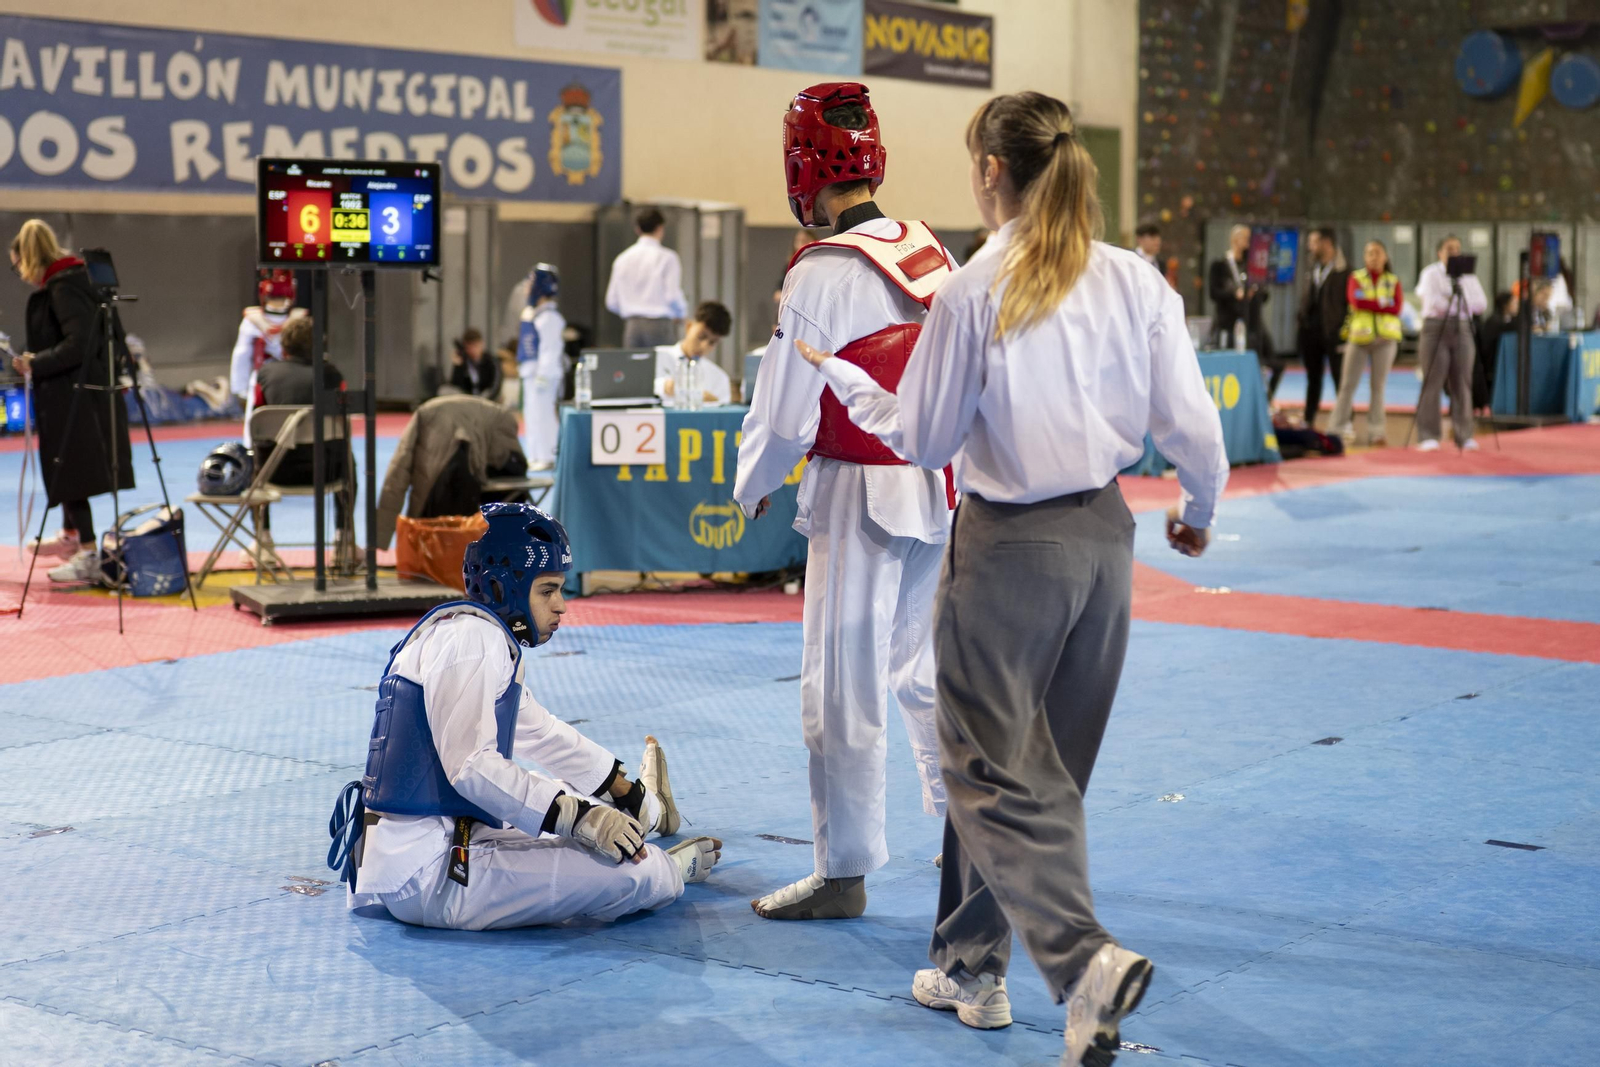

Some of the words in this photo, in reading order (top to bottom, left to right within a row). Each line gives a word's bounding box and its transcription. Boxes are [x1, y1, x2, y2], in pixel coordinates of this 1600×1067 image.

[264, 59, 535, 123] MUNICIPAL
[306, 179, 332, 189] Ricardo
[367, 181, 398, 191] Alejandro
[268, 190, 287, 200] ESP
[413, 193, 433, 204] ESP
[300, 204, 320, 234] 6
[334, 213, 367, 229] 0:36
[381, 206, 400, 235] 3
[600, 423, 621, 455] 0
[636, 422, 656, 454] 2
